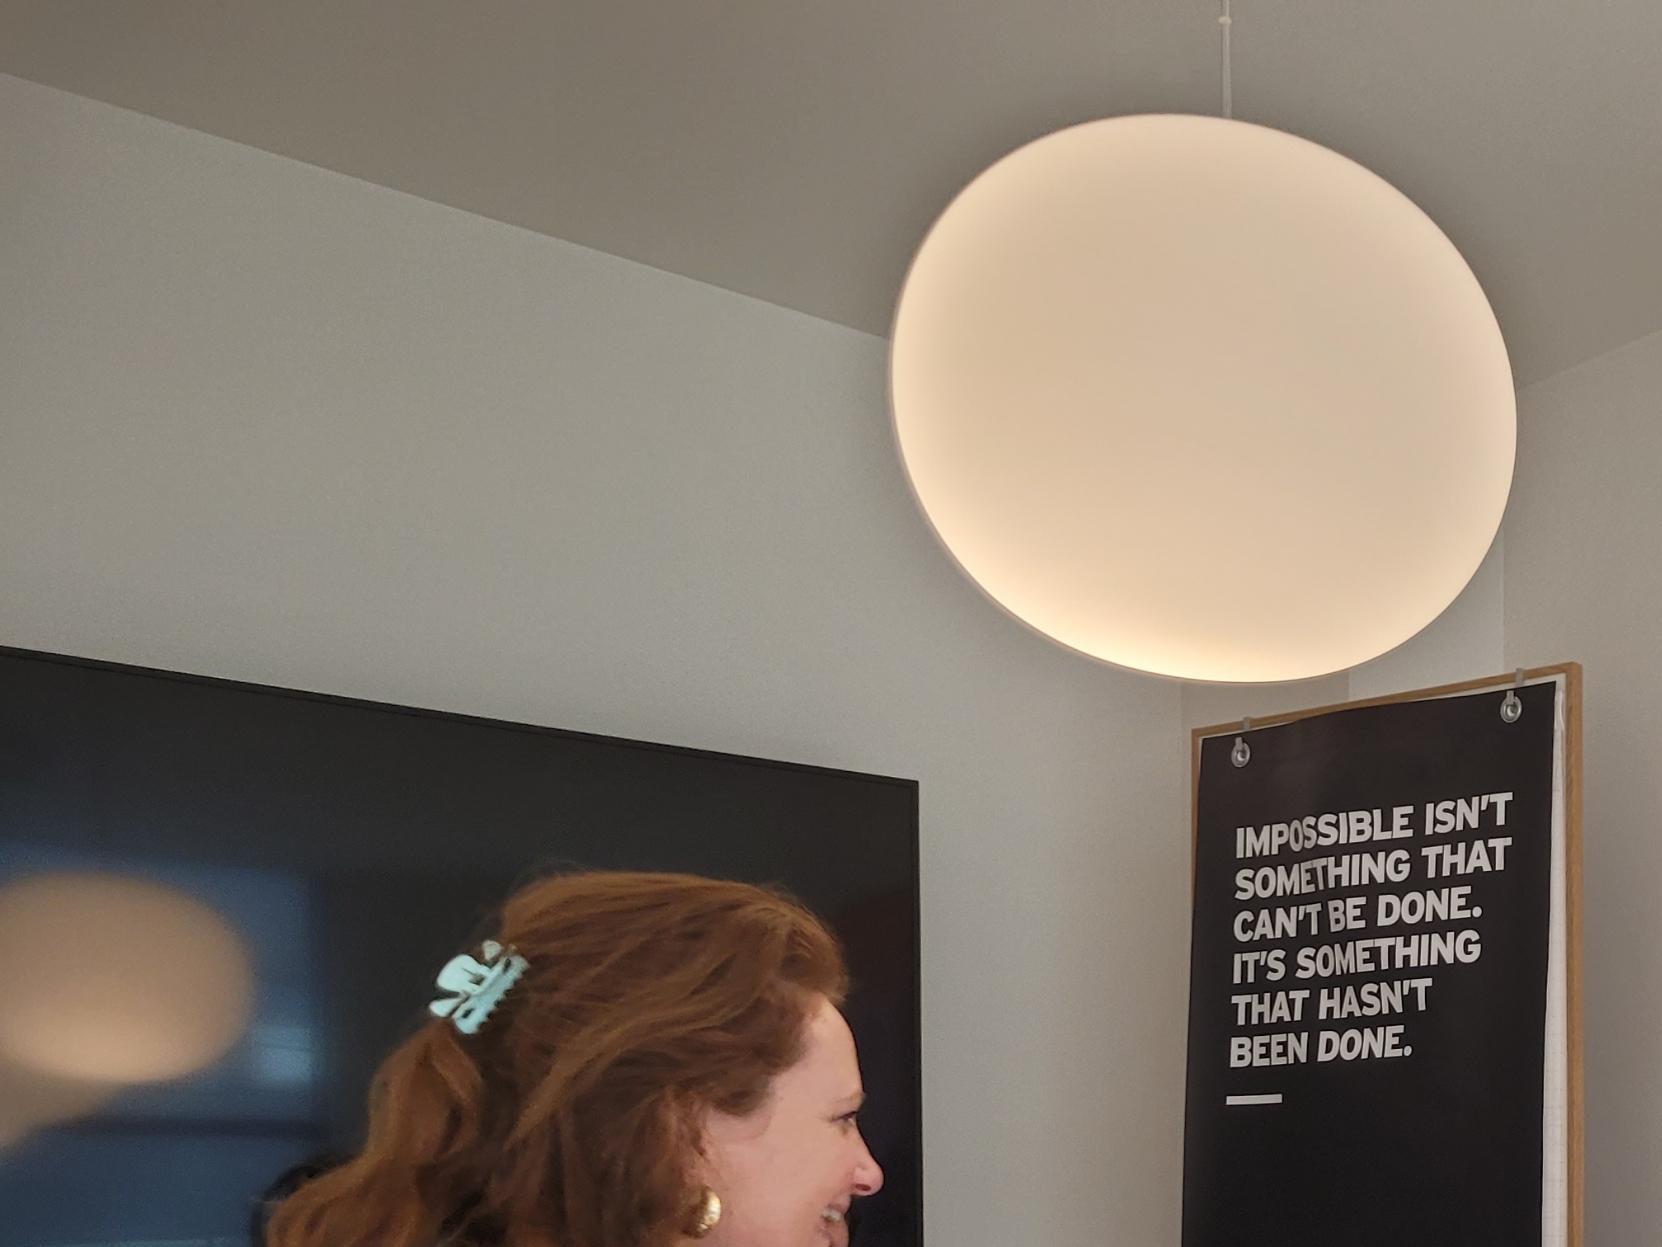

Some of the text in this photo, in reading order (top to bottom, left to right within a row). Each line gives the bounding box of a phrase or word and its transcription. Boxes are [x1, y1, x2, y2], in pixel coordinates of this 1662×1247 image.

[1236, 792, 1513, 858] IMPOSSIBLE ISN'T
[1235, 837, 1512, 900] SOMETHING THAT
[1233, 886, 1482, 942] CAN'T BE DONE.
[1232, 929, 1481, 984] IT'S SOMETHING
[1231, 978, 1432, 1026] THAT HASN'T
[1230, 1025, 1412, 1068] BEEN DONE.
